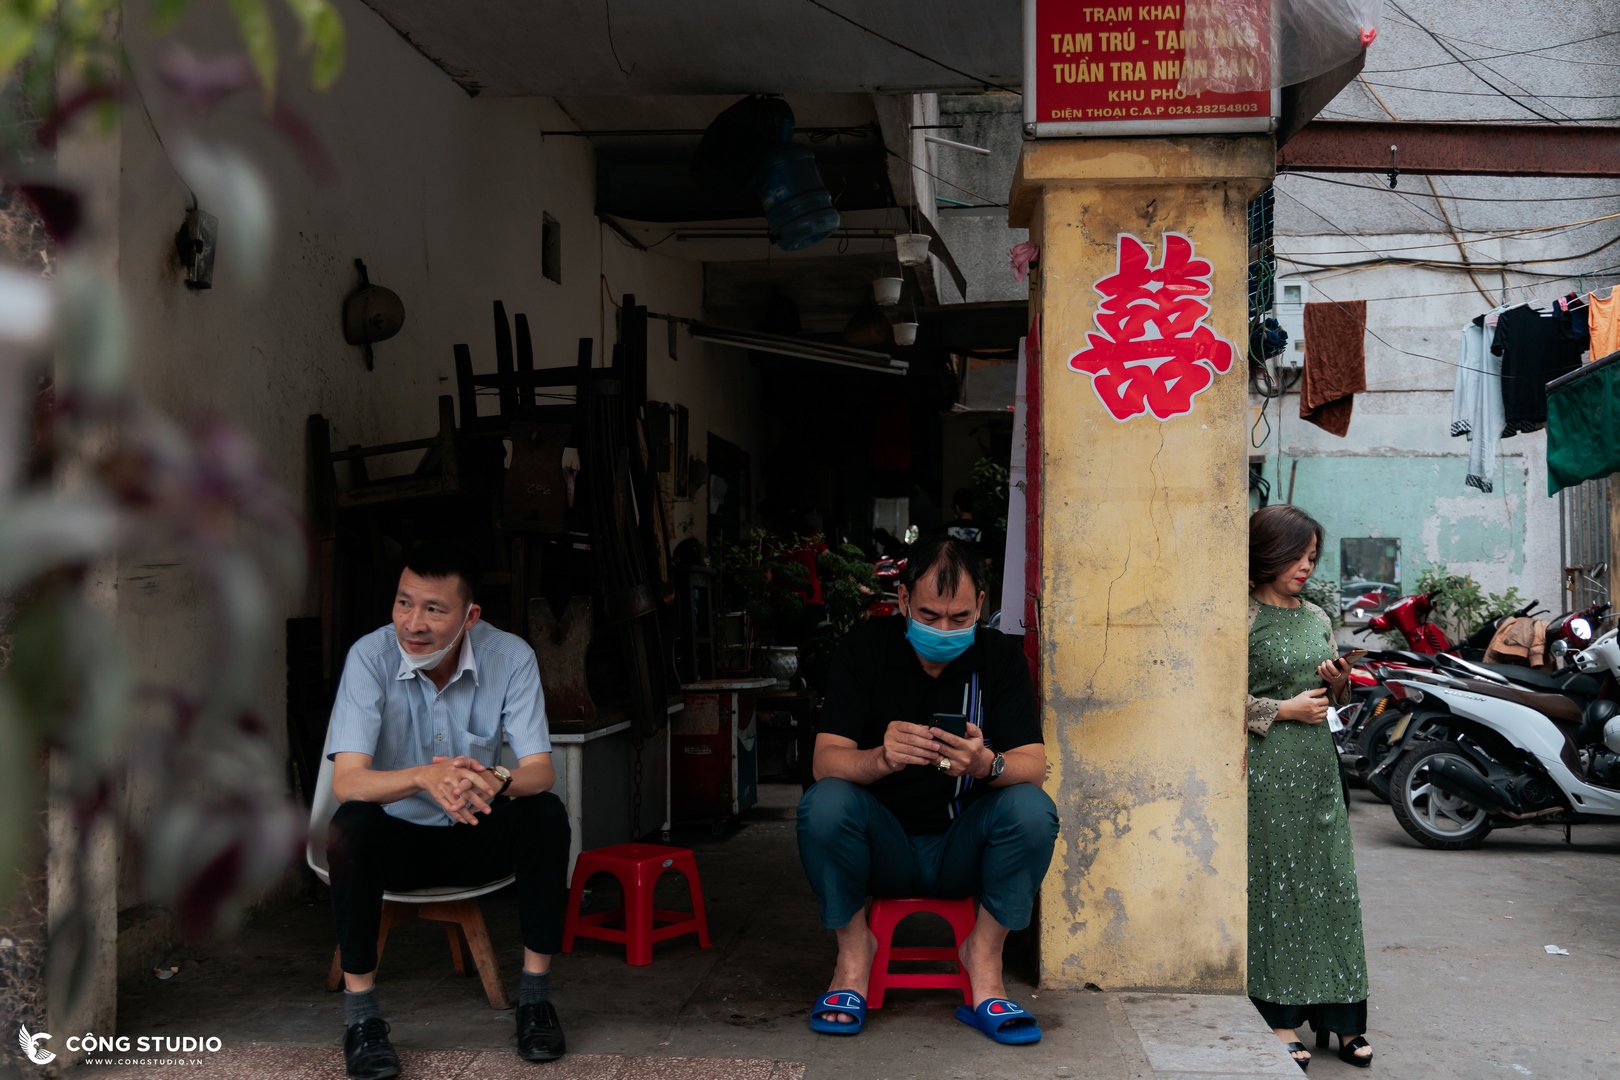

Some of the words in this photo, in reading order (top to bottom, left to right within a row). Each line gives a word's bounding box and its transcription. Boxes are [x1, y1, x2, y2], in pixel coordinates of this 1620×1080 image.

[1083, 7, 1133, 26] TRẠM
[1138, 5, 1181, 21] KHAI
[1051, 33, 1093, 57] TẠM
[1099, 28, 1136, 52] TRÚ
[1155, 29, 1197, 54] TẠM
[1053, 56, 1104, 84] TUẦN
[1110, 61, 1147, 81] TRA
[1108, 90, 1145, 102] KHU
[1051, 106, 1084, 121] ĐIỆN
[1086, 107, 1126, 120] THOẠI
[1130, 106, 1165, 117] C.A.P
[1168, 103, 1258, 115] 024.38254803
